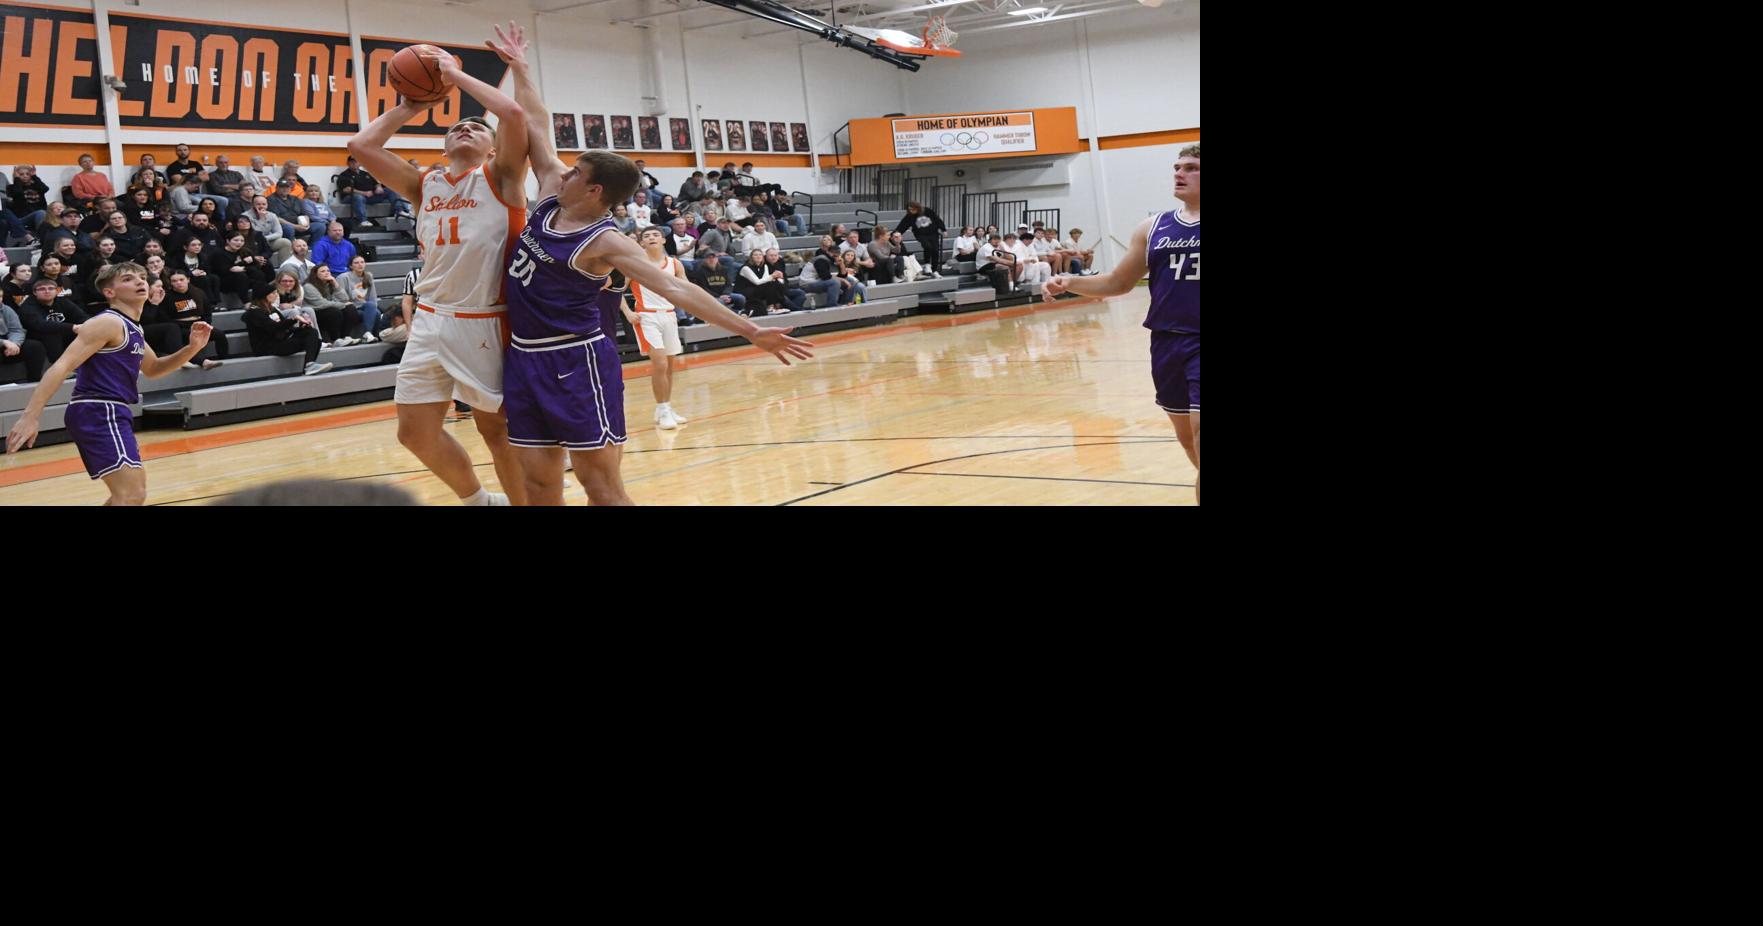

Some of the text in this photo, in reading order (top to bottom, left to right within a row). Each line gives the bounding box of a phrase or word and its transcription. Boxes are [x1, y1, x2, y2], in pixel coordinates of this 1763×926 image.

[142, 63, 337, 93] HOME OF THE
[917, 116, 1009, 131] HOME OF OLYMPIAN
[435, 216, 461, 246] 11
[1169, 252, 1200, 281] 43
